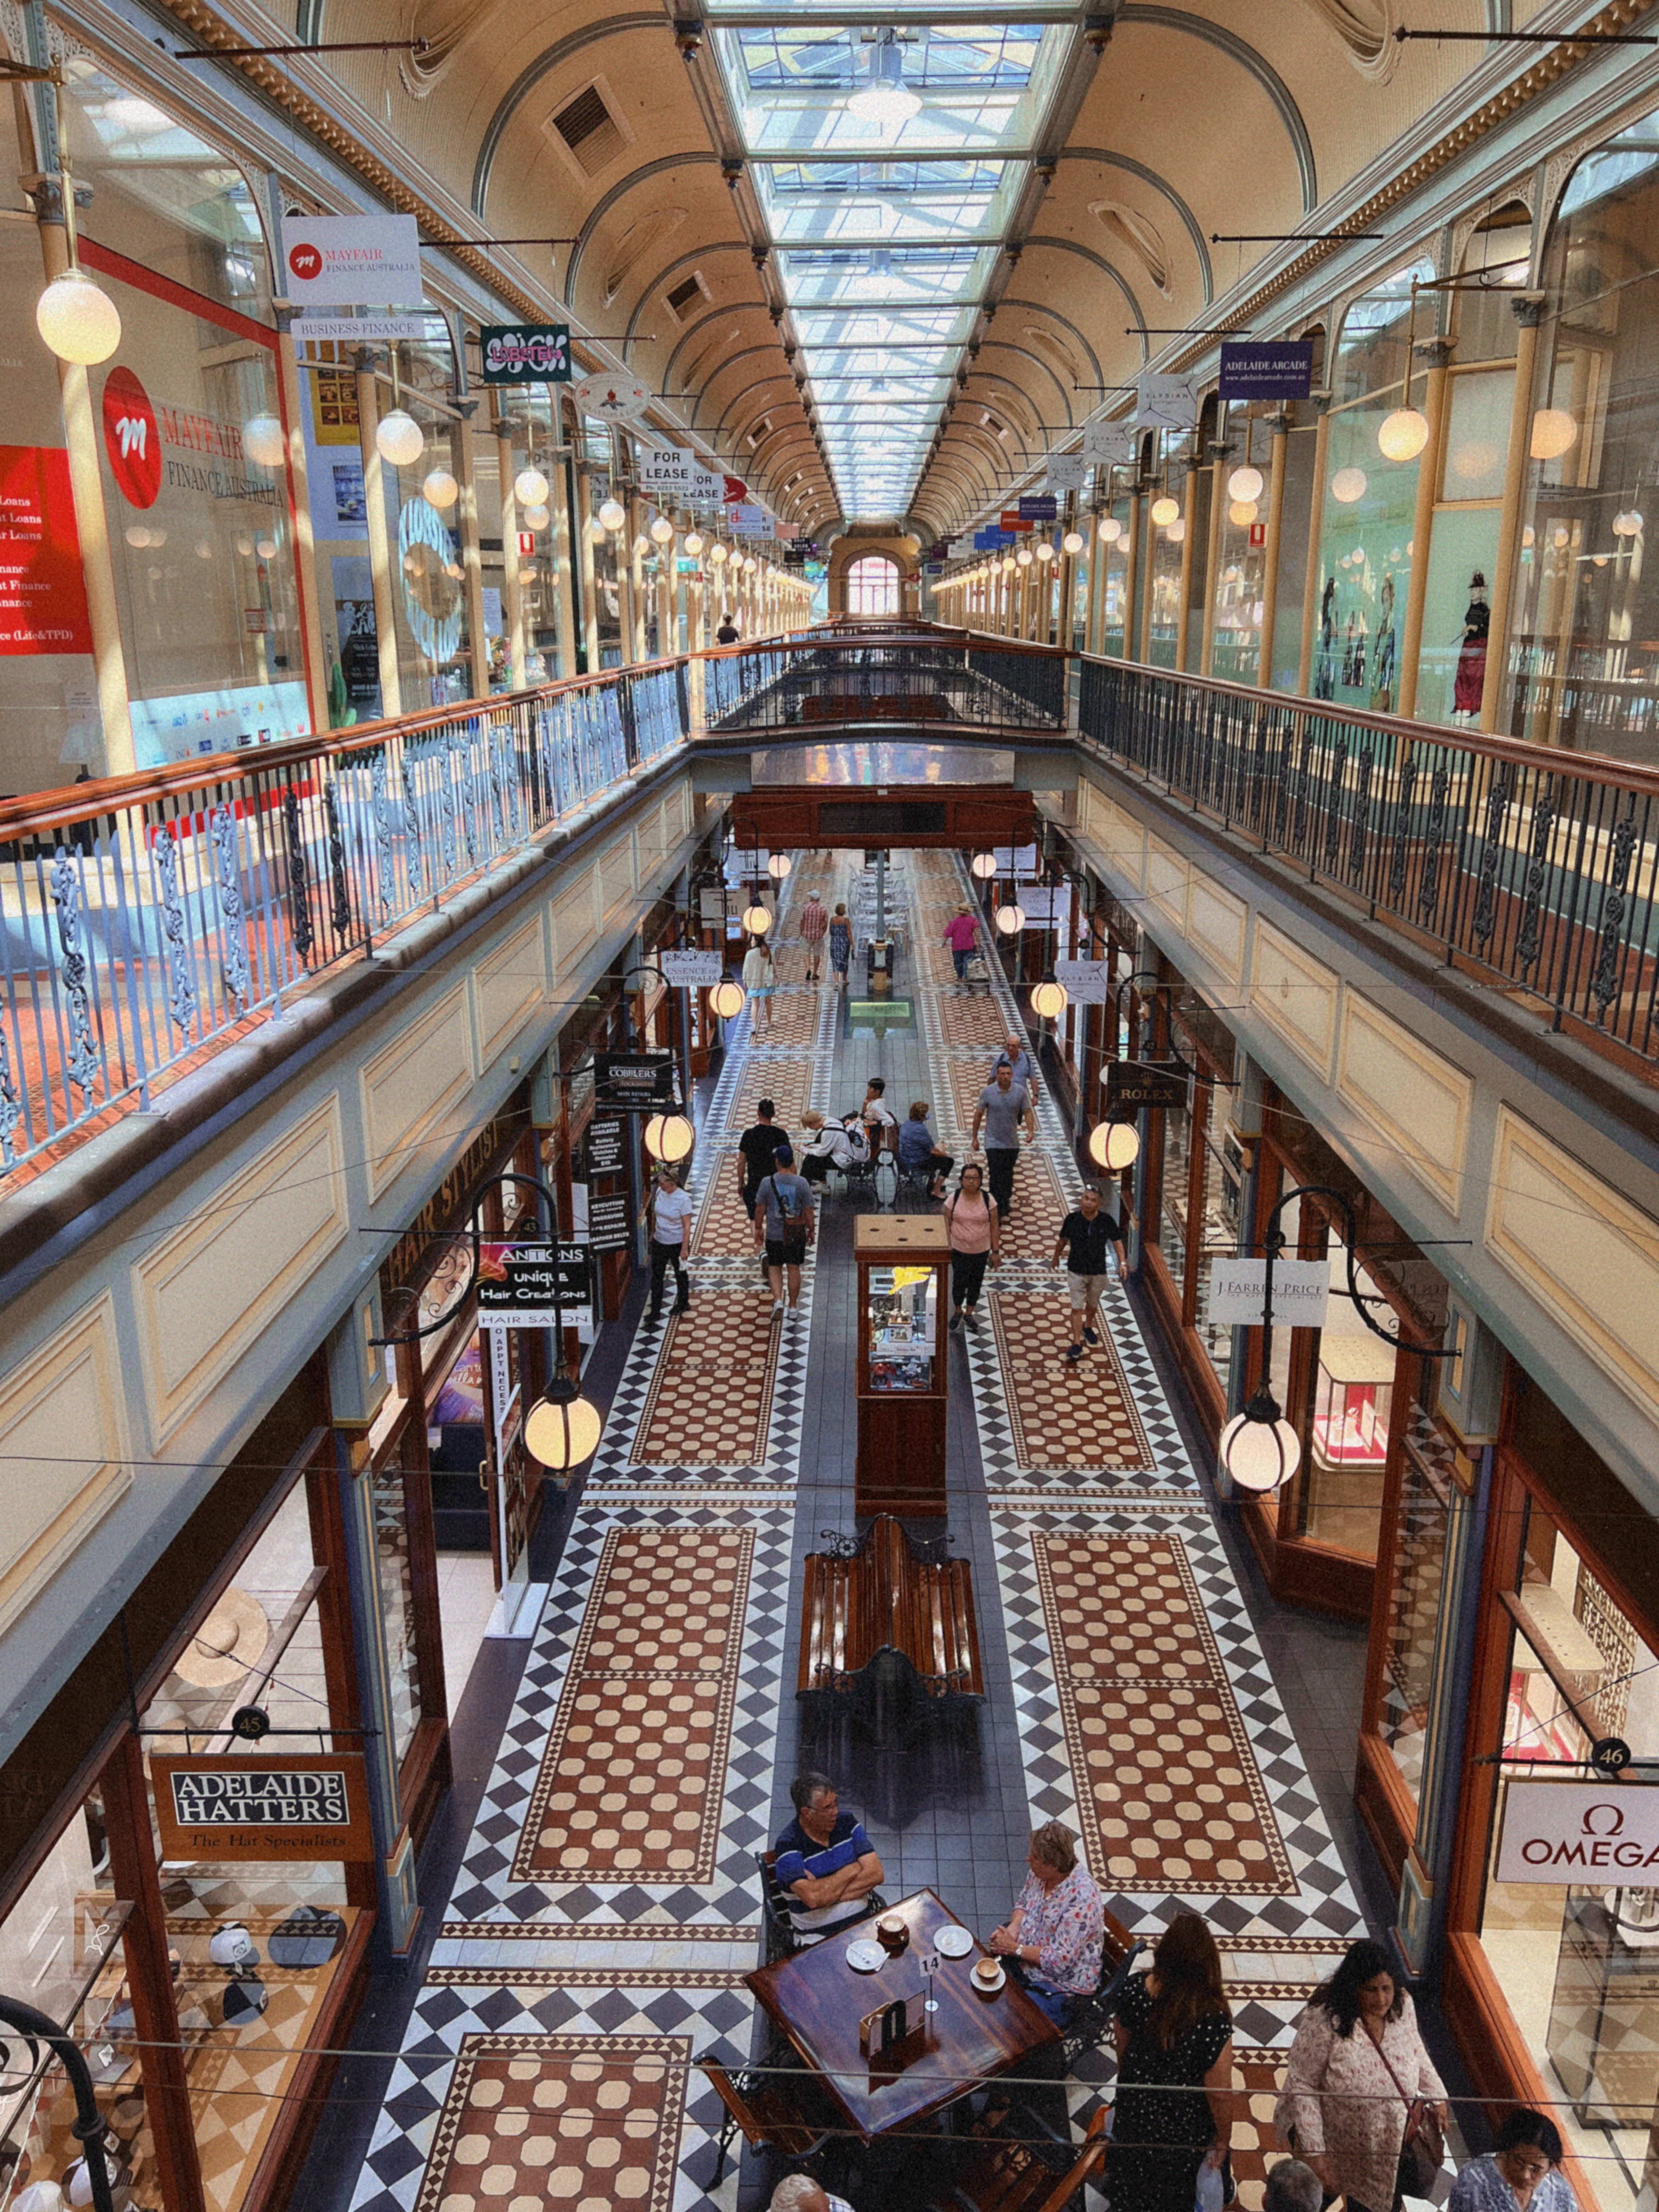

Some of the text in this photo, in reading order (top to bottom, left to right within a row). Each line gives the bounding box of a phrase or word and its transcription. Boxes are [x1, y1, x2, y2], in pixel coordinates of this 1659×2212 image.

[325, 249, 382, 261] MAYFAIR
[367, 263, 414, 272] AUSTRALIA
[302, 323, 414, 335] BUSINESS FINANCE
[1225, 360, 1308, 371] ADELAIDE ARCADE
[161, 406, 244, 460] MAYFAIR
[654, 453, 680, 462] FOR
[646, 469, 689, 479] LEASE
[167, 460, 284, 508] FINANCE AUSTRALIA
[10, 513, 42, 523] Loans
[10, 529, 42, 540] Loans
[10, 580, 51, 591] Finance
[14, 630, 73, 641] (Life&TPD)
[667, 975, 718, 984] AUSTRALIA
[609, 1069, 657, 1077] COBBLERS
[1121, 1090, 1173, 1099] ROLEX
[590, 1121, 619, 1130] BATTERIES
[590, 1127, 620, 1136] AVAILABLE
[523, 1222, 537, 1232] 43
[603, 1222, 627, 1230] REPAIRS
[1284, 1284, 1322, 1295] PRICE
[239, 1718, 261, 1733] 45
[1599, 1748, 1624, 1764] 46
[178, 1775, 342, 1798] ADELAIDE
[179, 1799, 343, 1822] HATTERS
[189, 1834, 346, 1850] The Hat Specialists
[921, 1956, 939, 1971] 14
